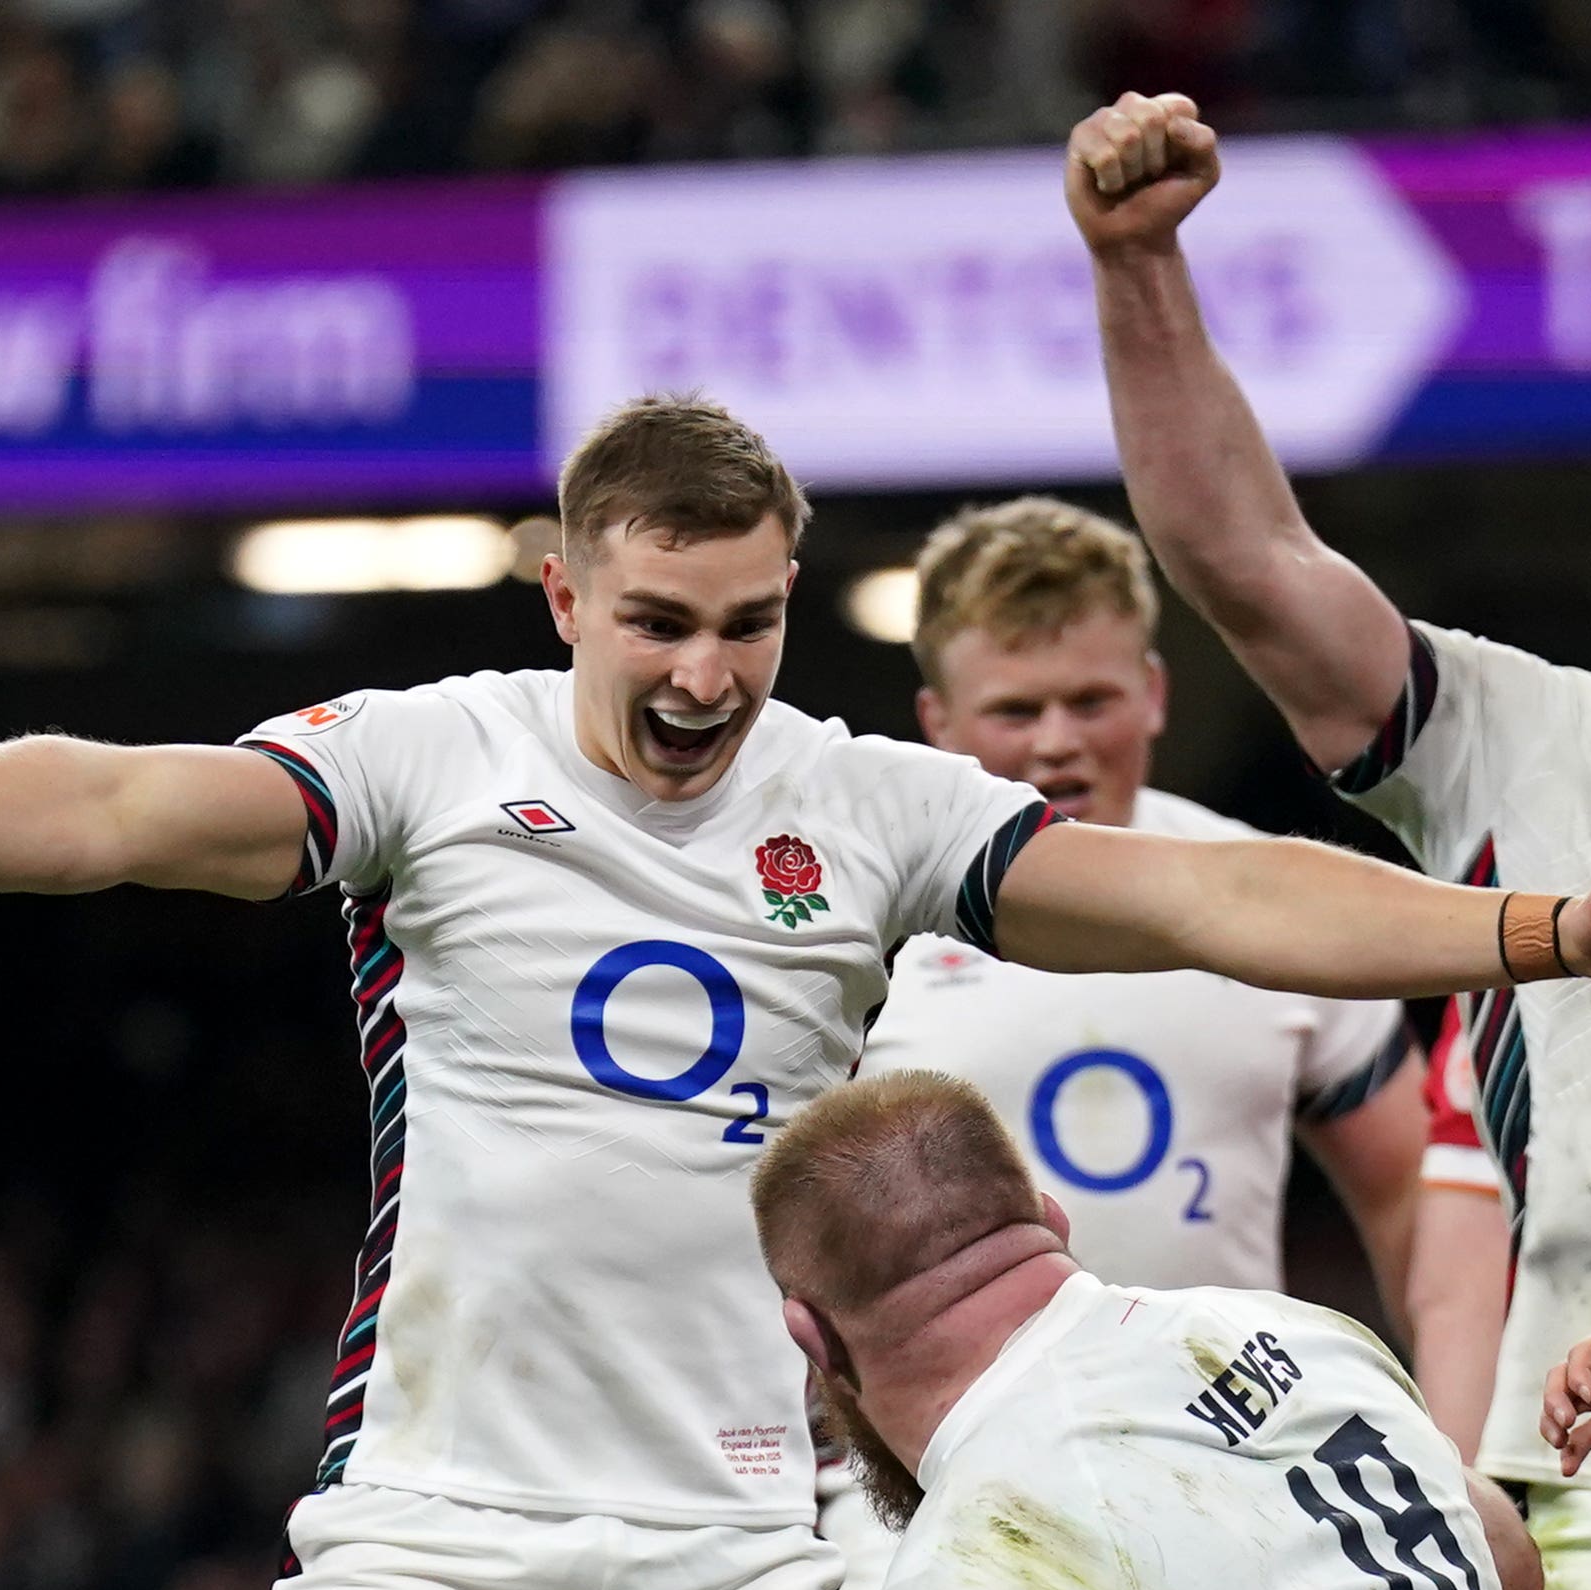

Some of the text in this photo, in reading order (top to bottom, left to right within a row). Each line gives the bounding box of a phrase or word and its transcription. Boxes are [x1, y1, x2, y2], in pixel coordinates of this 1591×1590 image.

[92, 240, 410, 432] firm
[570, 939, 772, 1145] O2
[1026, 1045, 1216, 1226] O2
[1185, 1330, 1303, 1447] HEYES
